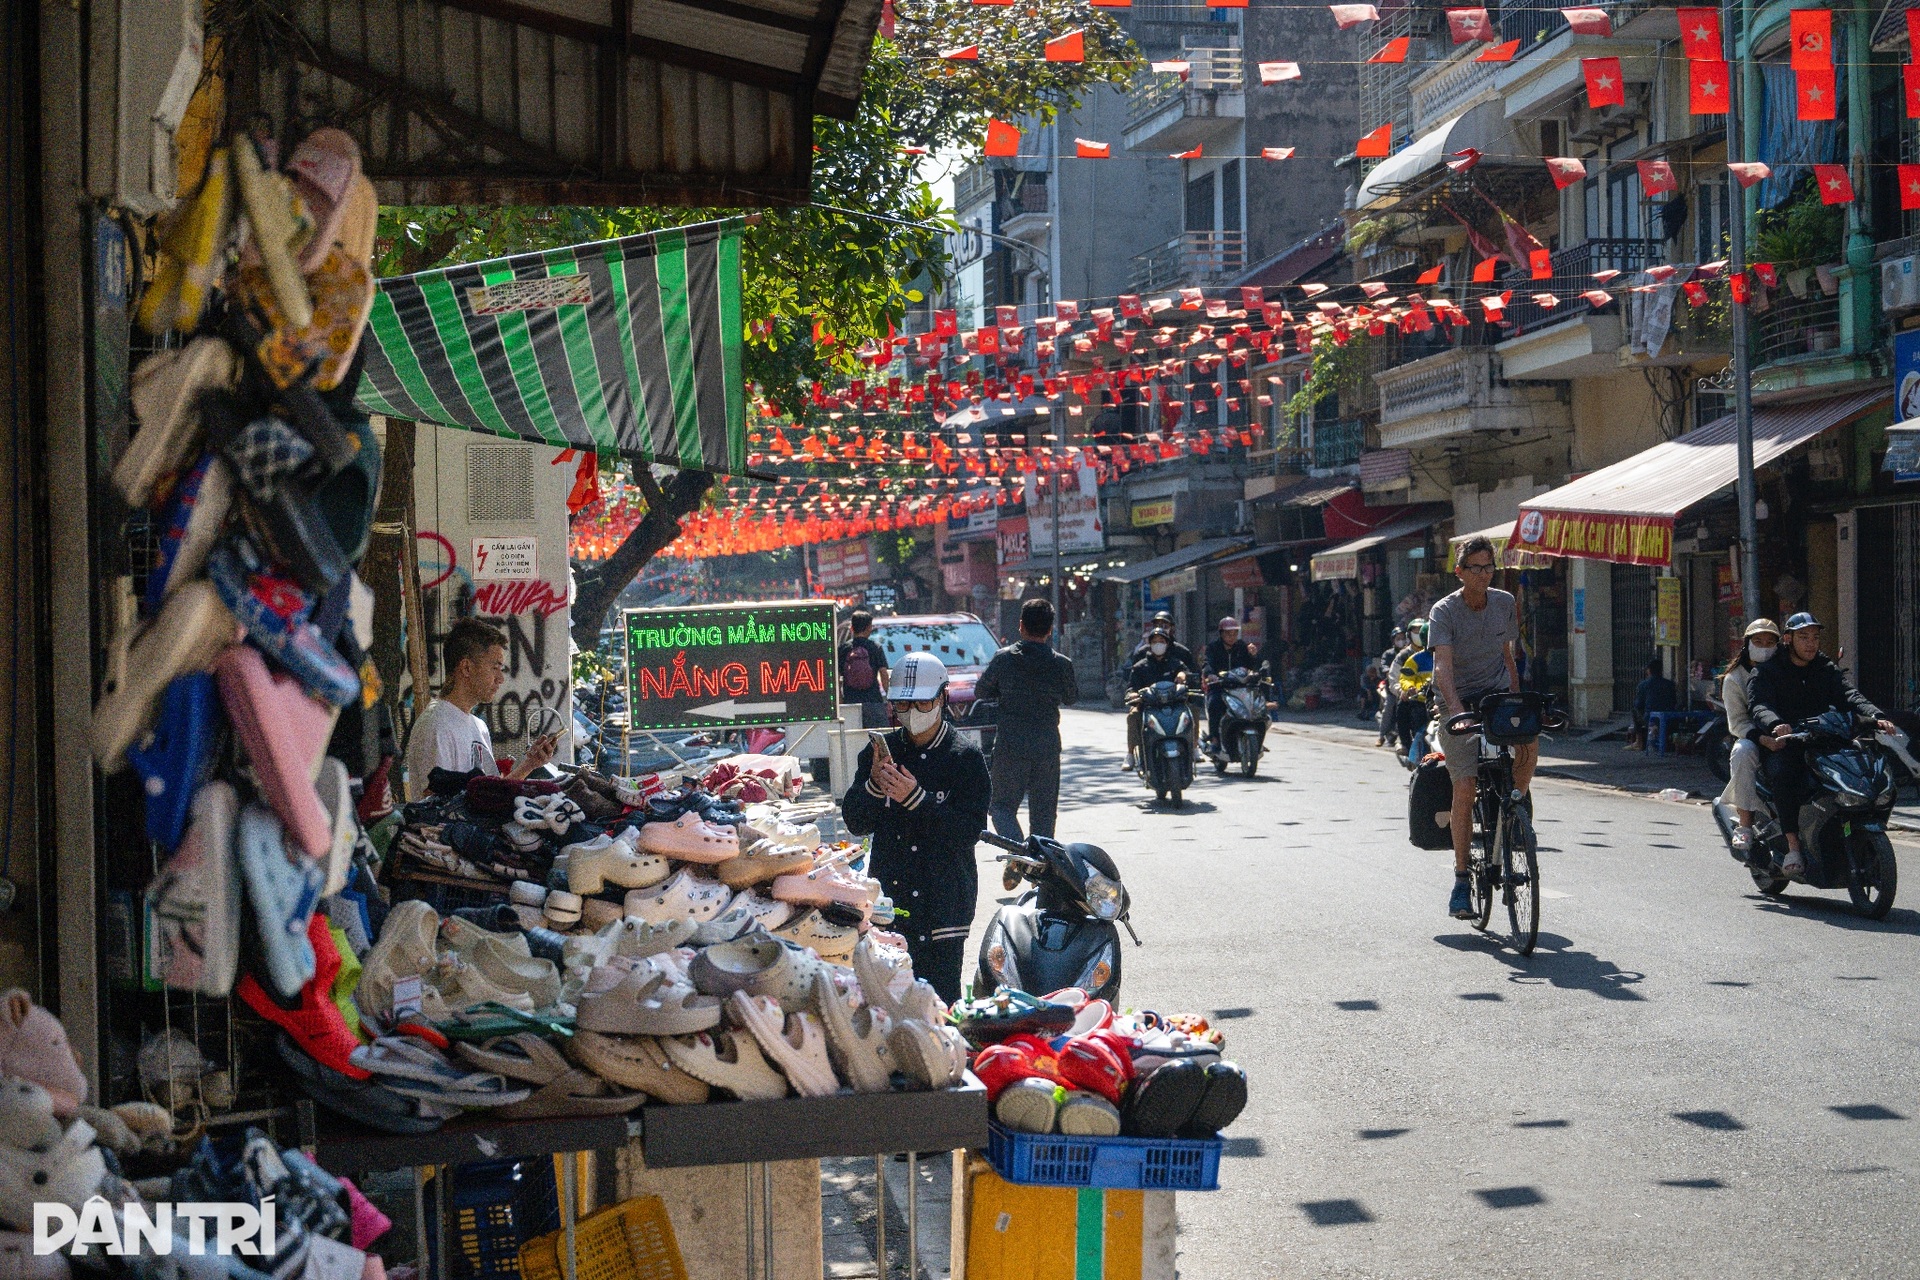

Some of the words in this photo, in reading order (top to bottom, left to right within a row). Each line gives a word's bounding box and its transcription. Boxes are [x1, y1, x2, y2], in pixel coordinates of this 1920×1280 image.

[633, 622, 723, 649] TRƯỜNG
[728, 615, 775, 644] MẦM
[781, 622, 827, 641] NON
[640, 650, 749, 700] NẮNG
[760, 659, 825, 694] MAI
